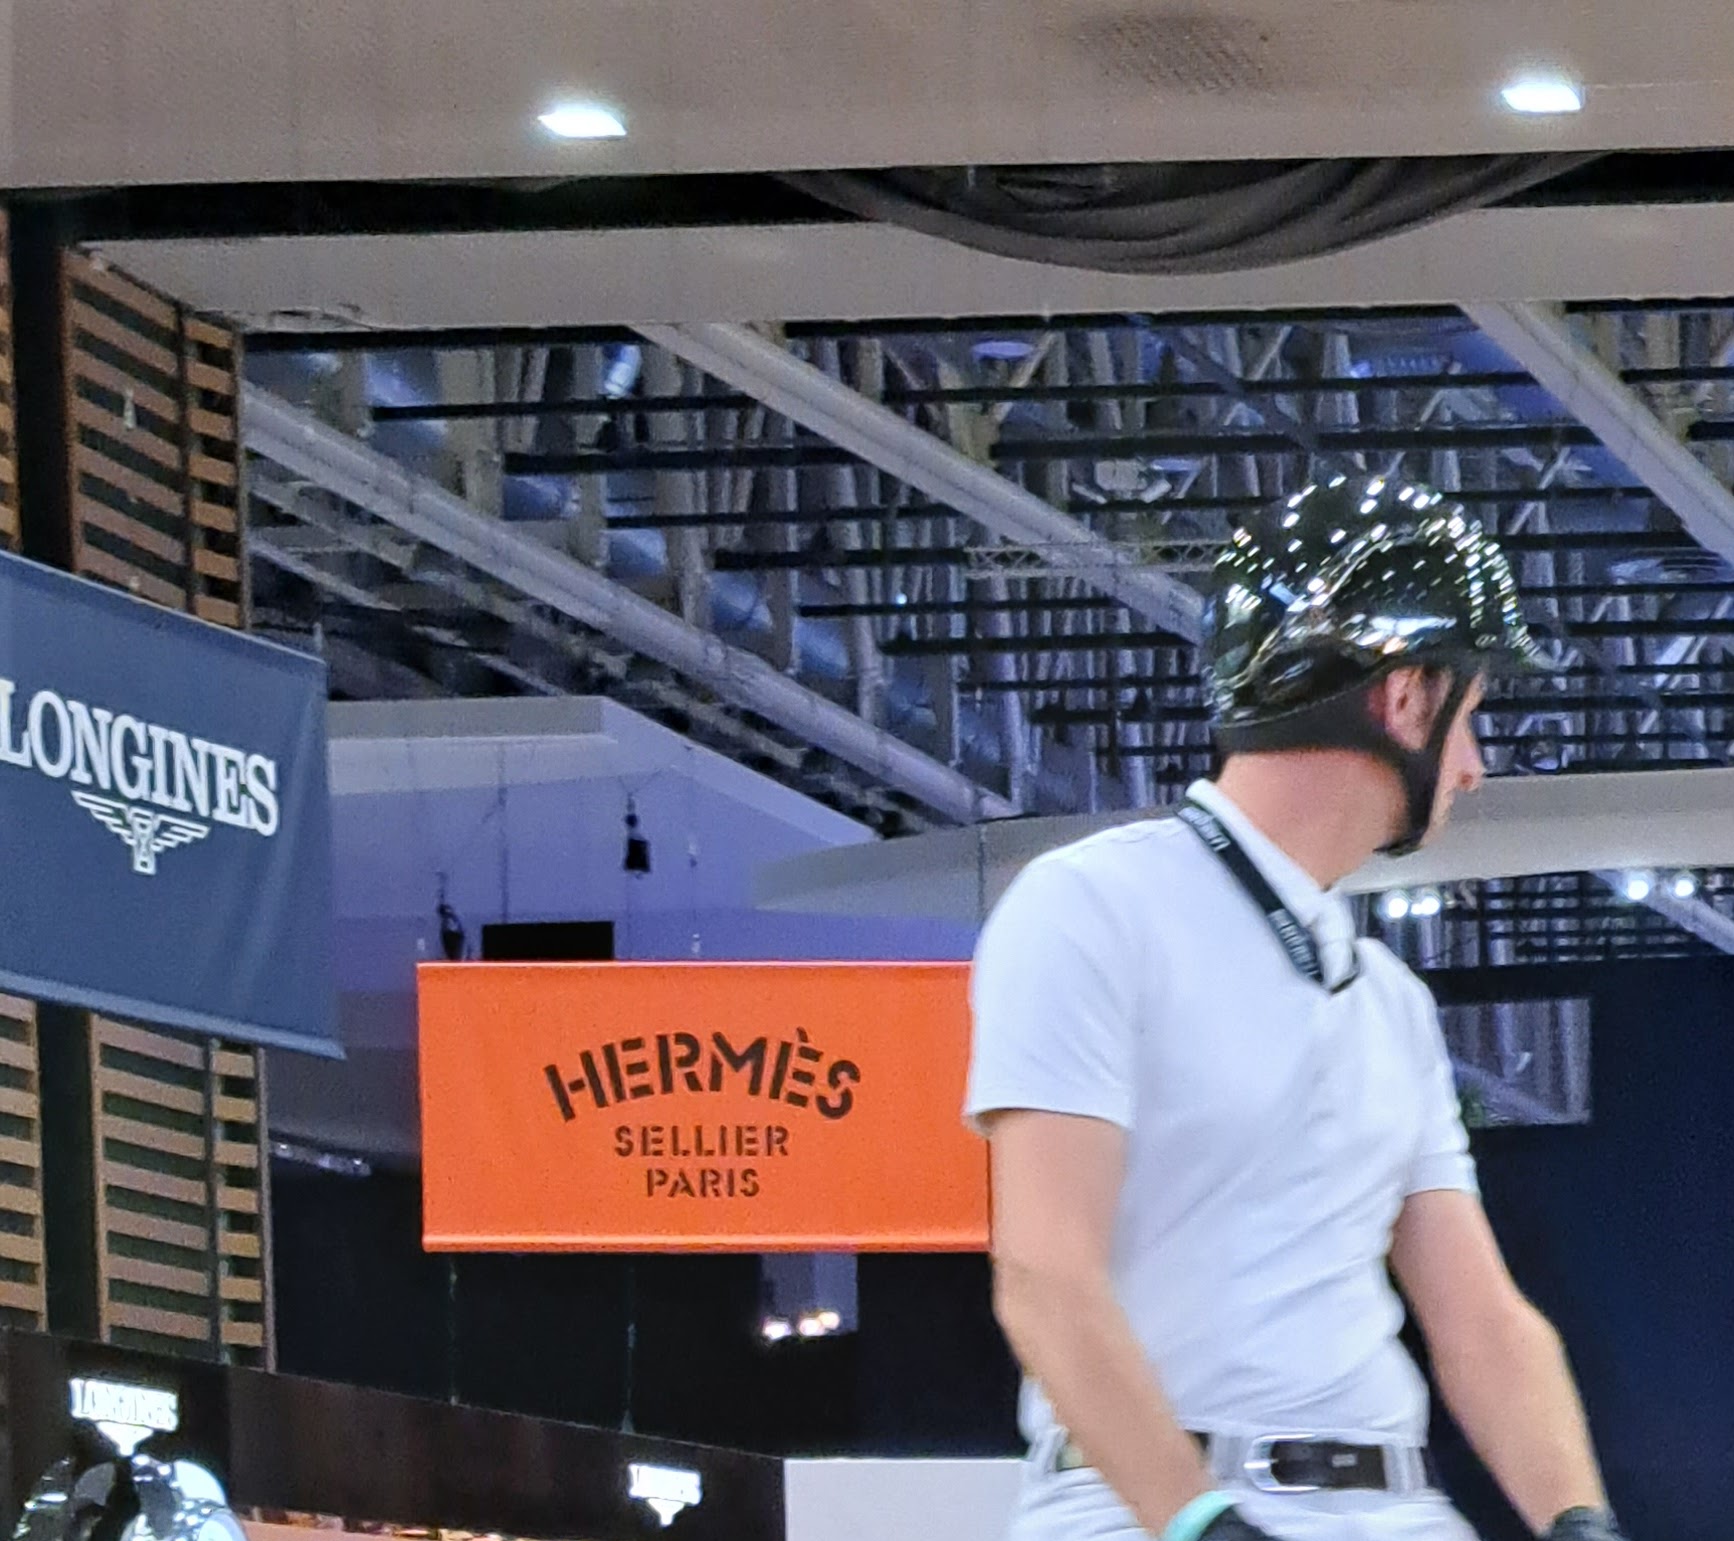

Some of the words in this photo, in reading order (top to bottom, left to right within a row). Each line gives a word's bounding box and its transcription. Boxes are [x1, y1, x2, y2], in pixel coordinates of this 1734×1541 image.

[0, 677, 279, 836] LONGINES
[543, 1026, 862, 1122] HERMÈS
[613, 1124, 790, 1157] SELLIER
[646, 1168, 760, 1198] PARIS
